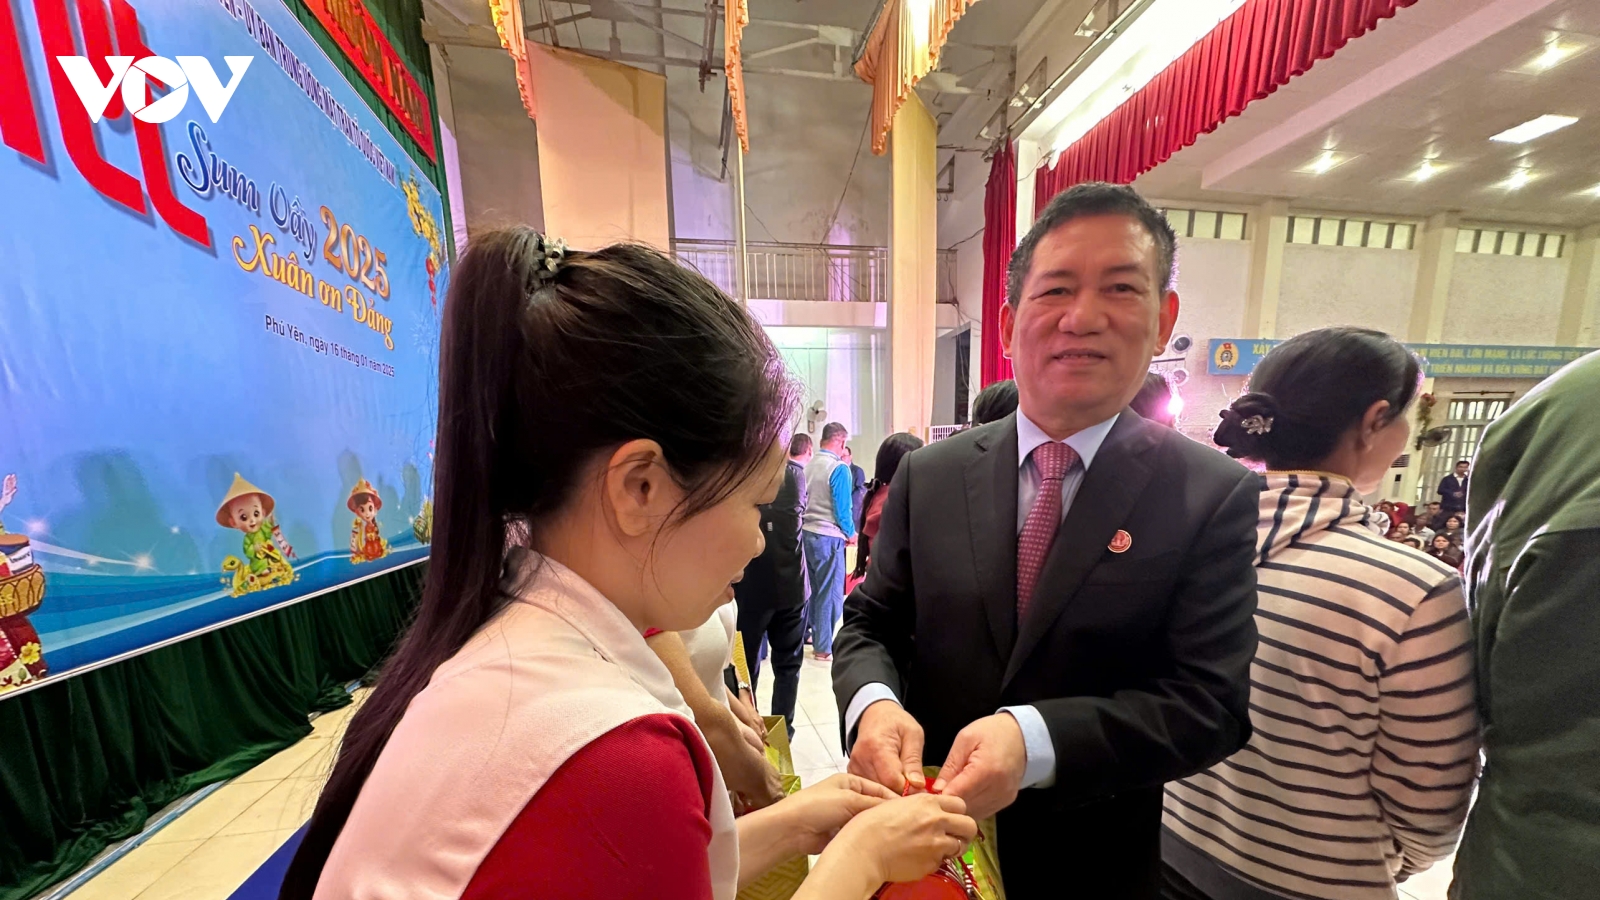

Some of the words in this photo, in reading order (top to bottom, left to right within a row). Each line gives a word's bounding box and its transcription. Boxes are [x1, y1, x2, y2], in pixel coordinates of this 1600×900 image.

[176, 120, 259, 212] Sum
[319, 205, 391, 299] 2025
[232, 224, 314, 299] Xuân
[318, 278, 343, 312] ơn
[344, 284, 395, 351] Đảng
[265, 314, 285, 336] Phú
[309, 335, 329, 356] ngày
[330, 342, 340, 357] 16
[340, 346, 360, 368] tháng
[360, 354, 368, 367] 01
[382, 362, 395, 378] 2025
